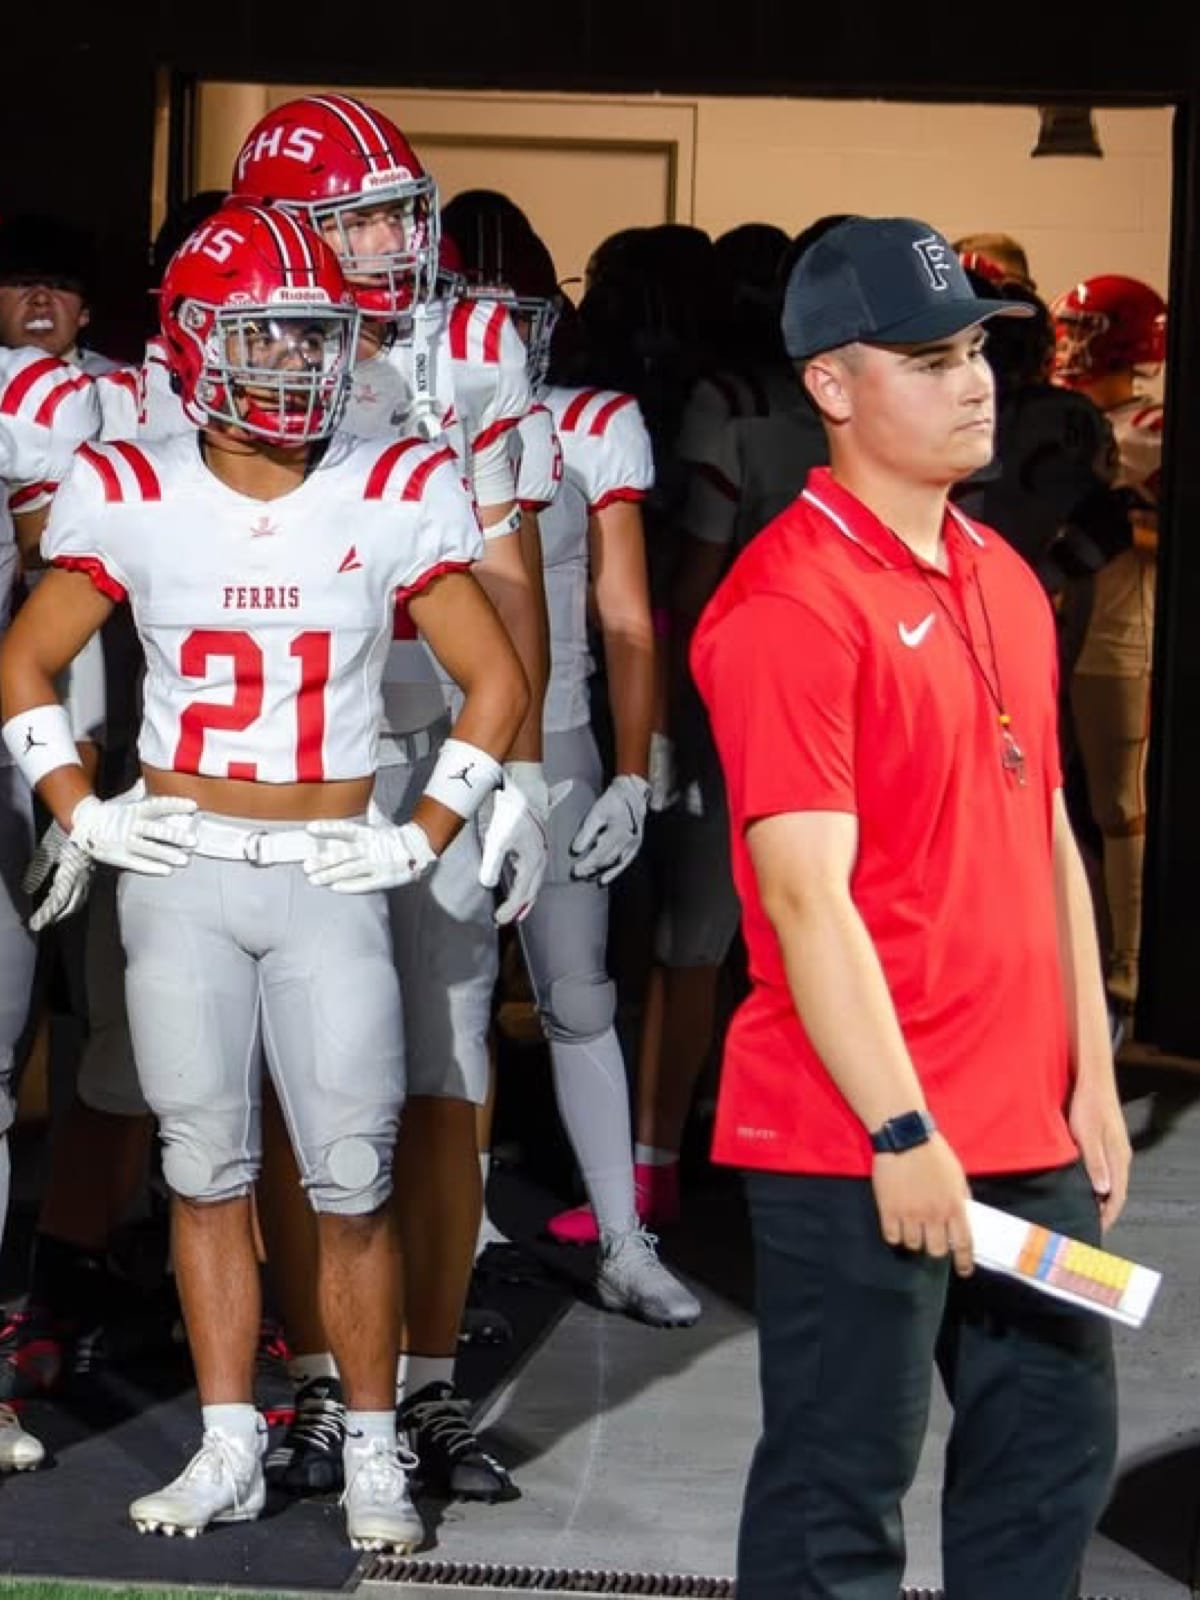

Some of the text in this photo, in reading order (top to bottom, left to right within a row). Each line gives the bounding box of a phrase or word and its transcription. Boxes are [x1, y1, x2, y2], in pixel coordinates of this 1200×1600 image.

[238, 127, 325, 182] FHS
[912, 235, 950, 291] F
[223, 586, 301, 609] FERRIS
[173, 629, 332, 784] 21
